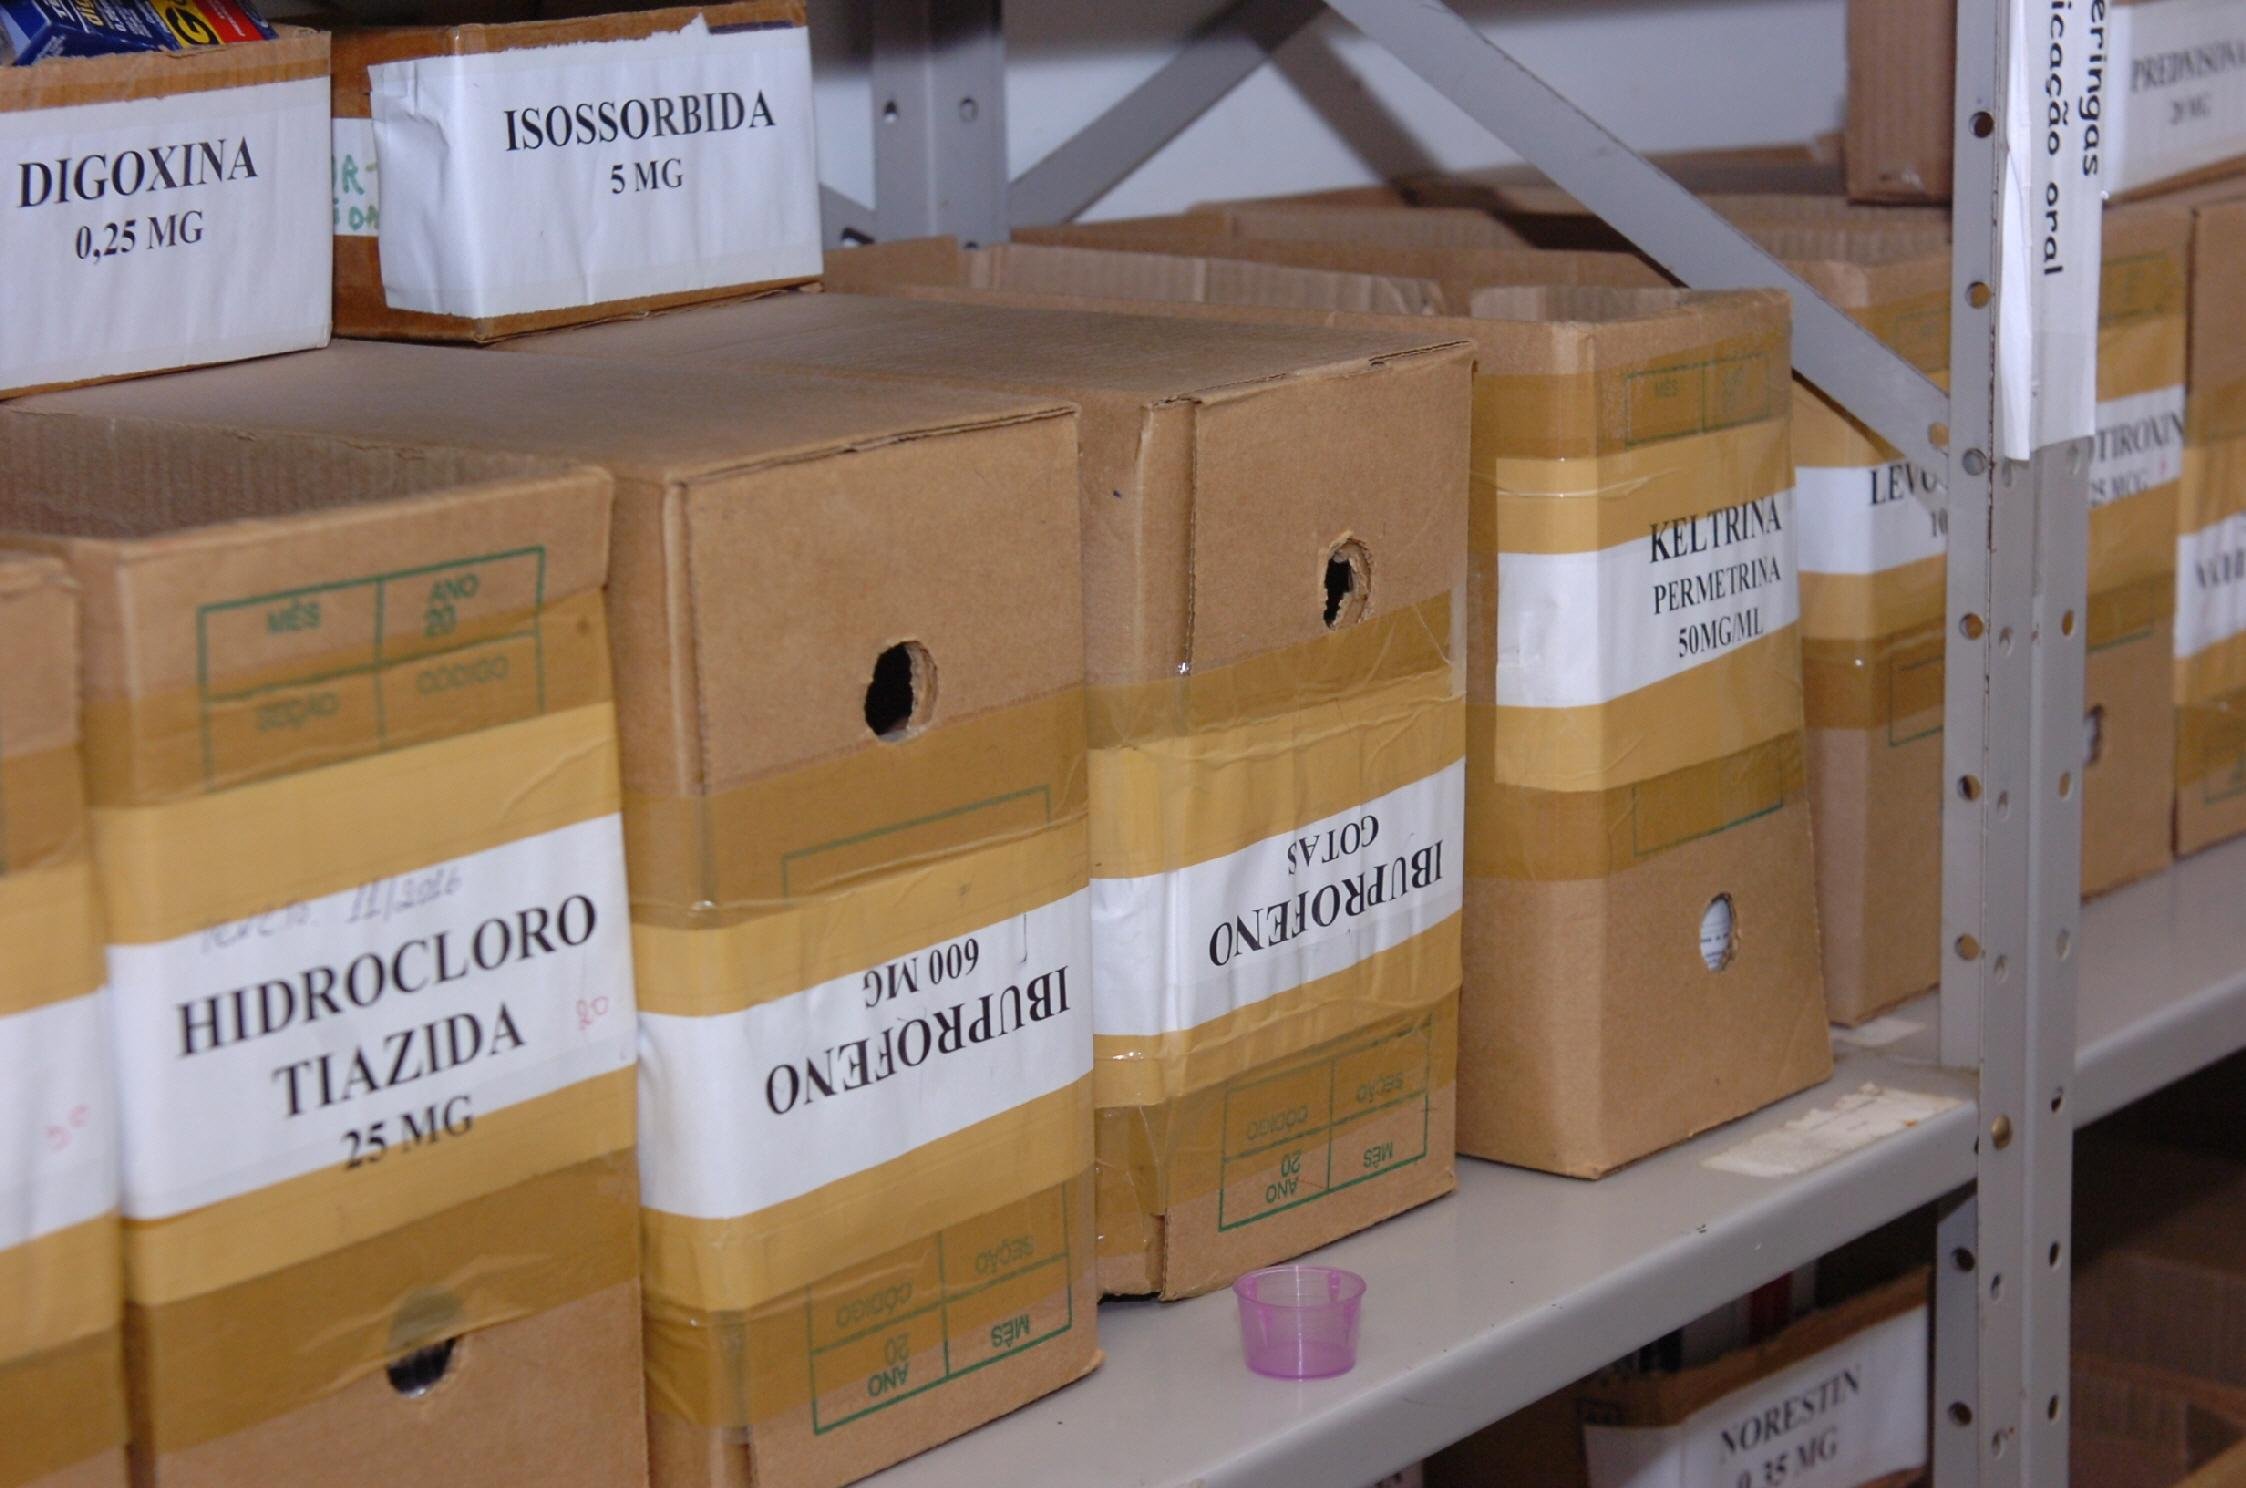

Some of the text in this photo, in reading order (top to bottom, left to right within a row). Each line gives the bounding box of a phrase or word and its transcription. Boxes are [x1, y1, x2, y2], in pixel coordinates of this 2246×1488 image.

[2079, 0, 2107, 177] eringas
[504, 89, 777, 154] ISOSSORBIDA
[2044, 0, 2072, 276] icação oral
[19, 136, 258, 209] DIGOXINA
[609, 157, 685, 196] 5 MG
[74, 209, 205, 264] 0,25 MG
[1650, 496, 1783, 564] KELTRINA
[431, 573, 480, 602] ANO
[1654, 555, 1782, 616] PERMETRINA
[424, 603, 456, 638] 20
[1679, 607, 1764, 658] 50MG/ML
[1287, 814, 1380, 876] GOTAS
[1208, 839, 1444, 967] IBUPROFENO
[177, 893, 598, 1058] HIDROCLORO
[862, 938, 980, 1009] 600 MG
[272, 1002, 527, 1118] TIAZIDA
[766, 965, 1072, 1115] IBUPROFENO
[342, 1094, 475, 1171] 25 MG
[1363, 1142, 1394, 1168] MÊS
[1265, 1178, 1298, 1204] ANO
[1281, 1152, 1302, 1178] 20
[883, 1333, 910, 1366] 20
[991, 1314, 1031, 1348] MÊS
[866, 1363, 910, 1397] ANO
[1720, 1364, 1862, 1456] NORESTIN
[1795, 1426, 1839, 1469] MG
